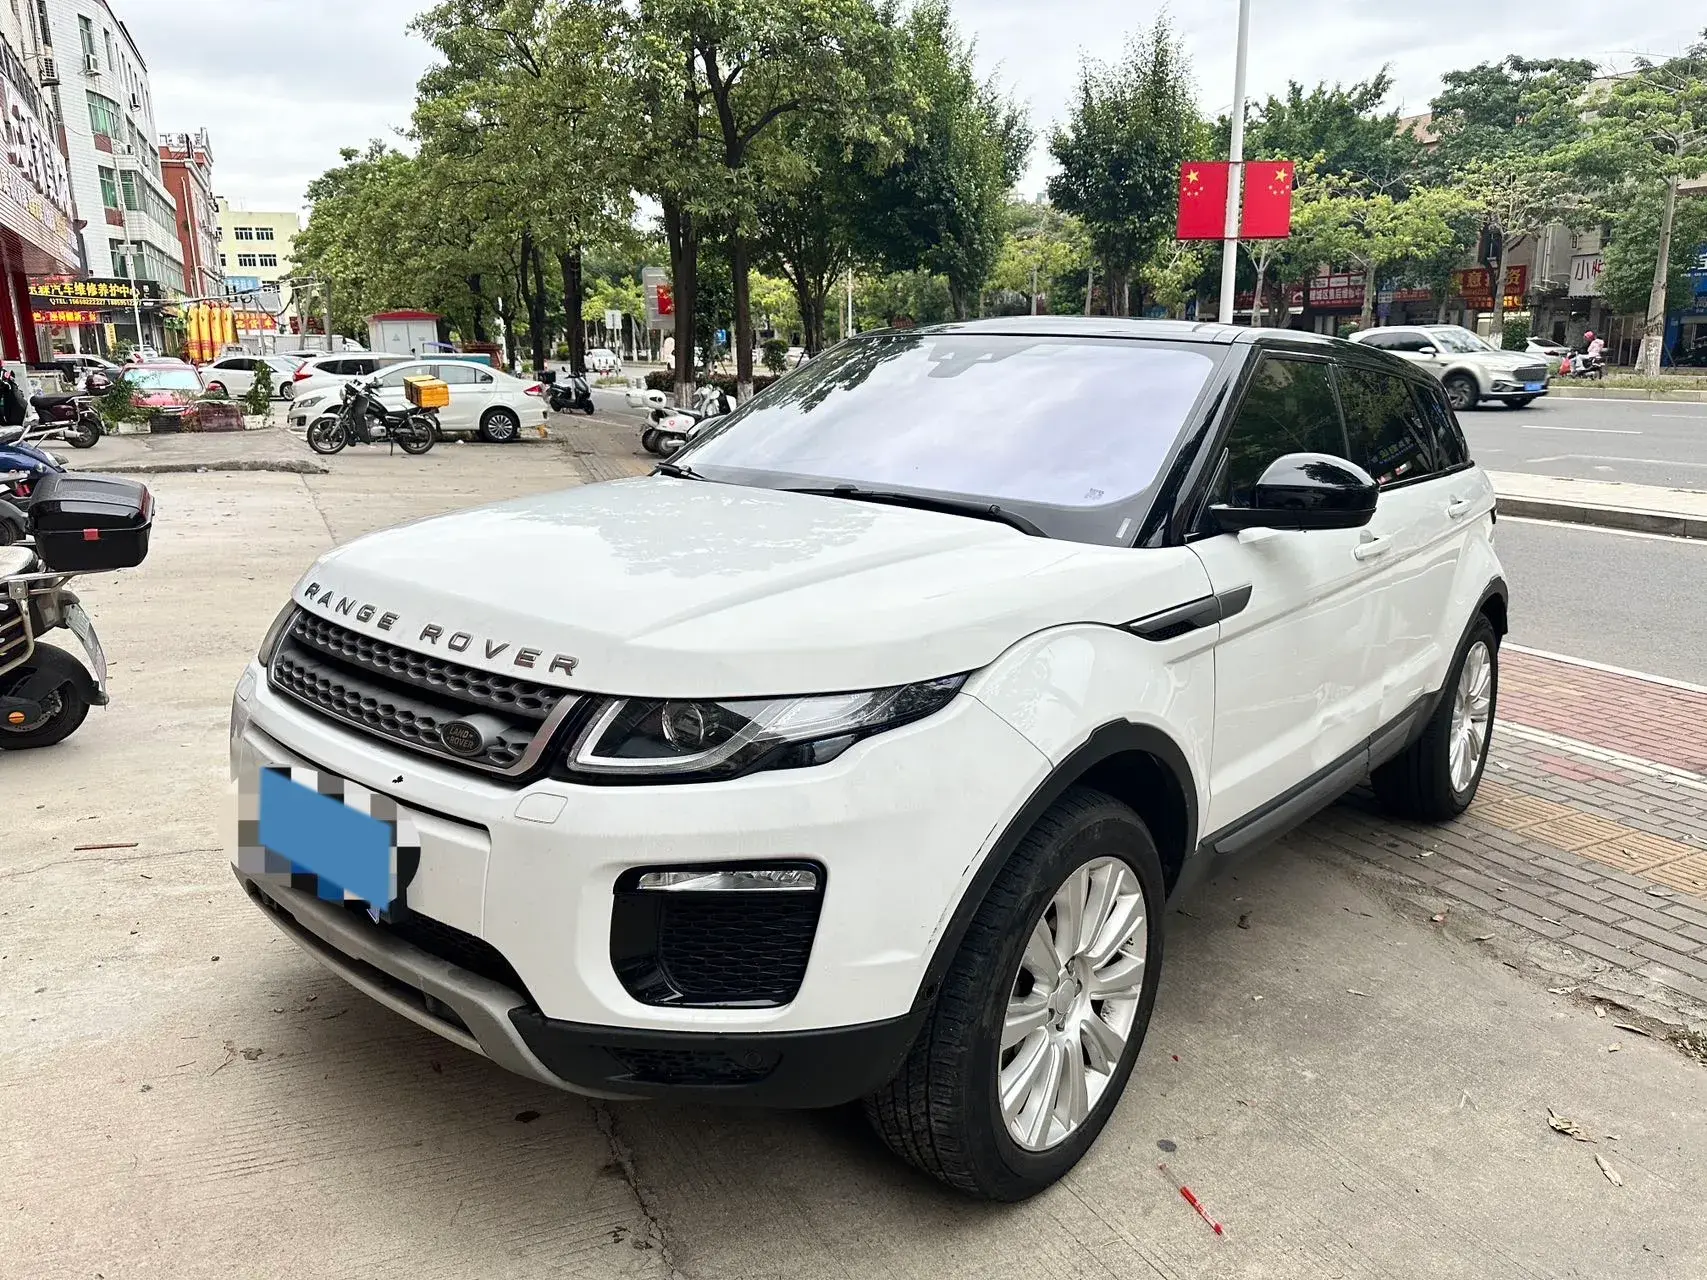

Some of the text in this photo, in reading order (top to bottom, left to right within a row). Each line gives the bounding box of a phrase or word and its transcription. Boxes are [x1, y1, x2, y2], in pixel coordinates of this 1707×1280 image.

[304, 581, 580, 676] RANGE ROVER
[449, 726, 470, 739] LAND
[449, 736, 474, 749] ROVER
